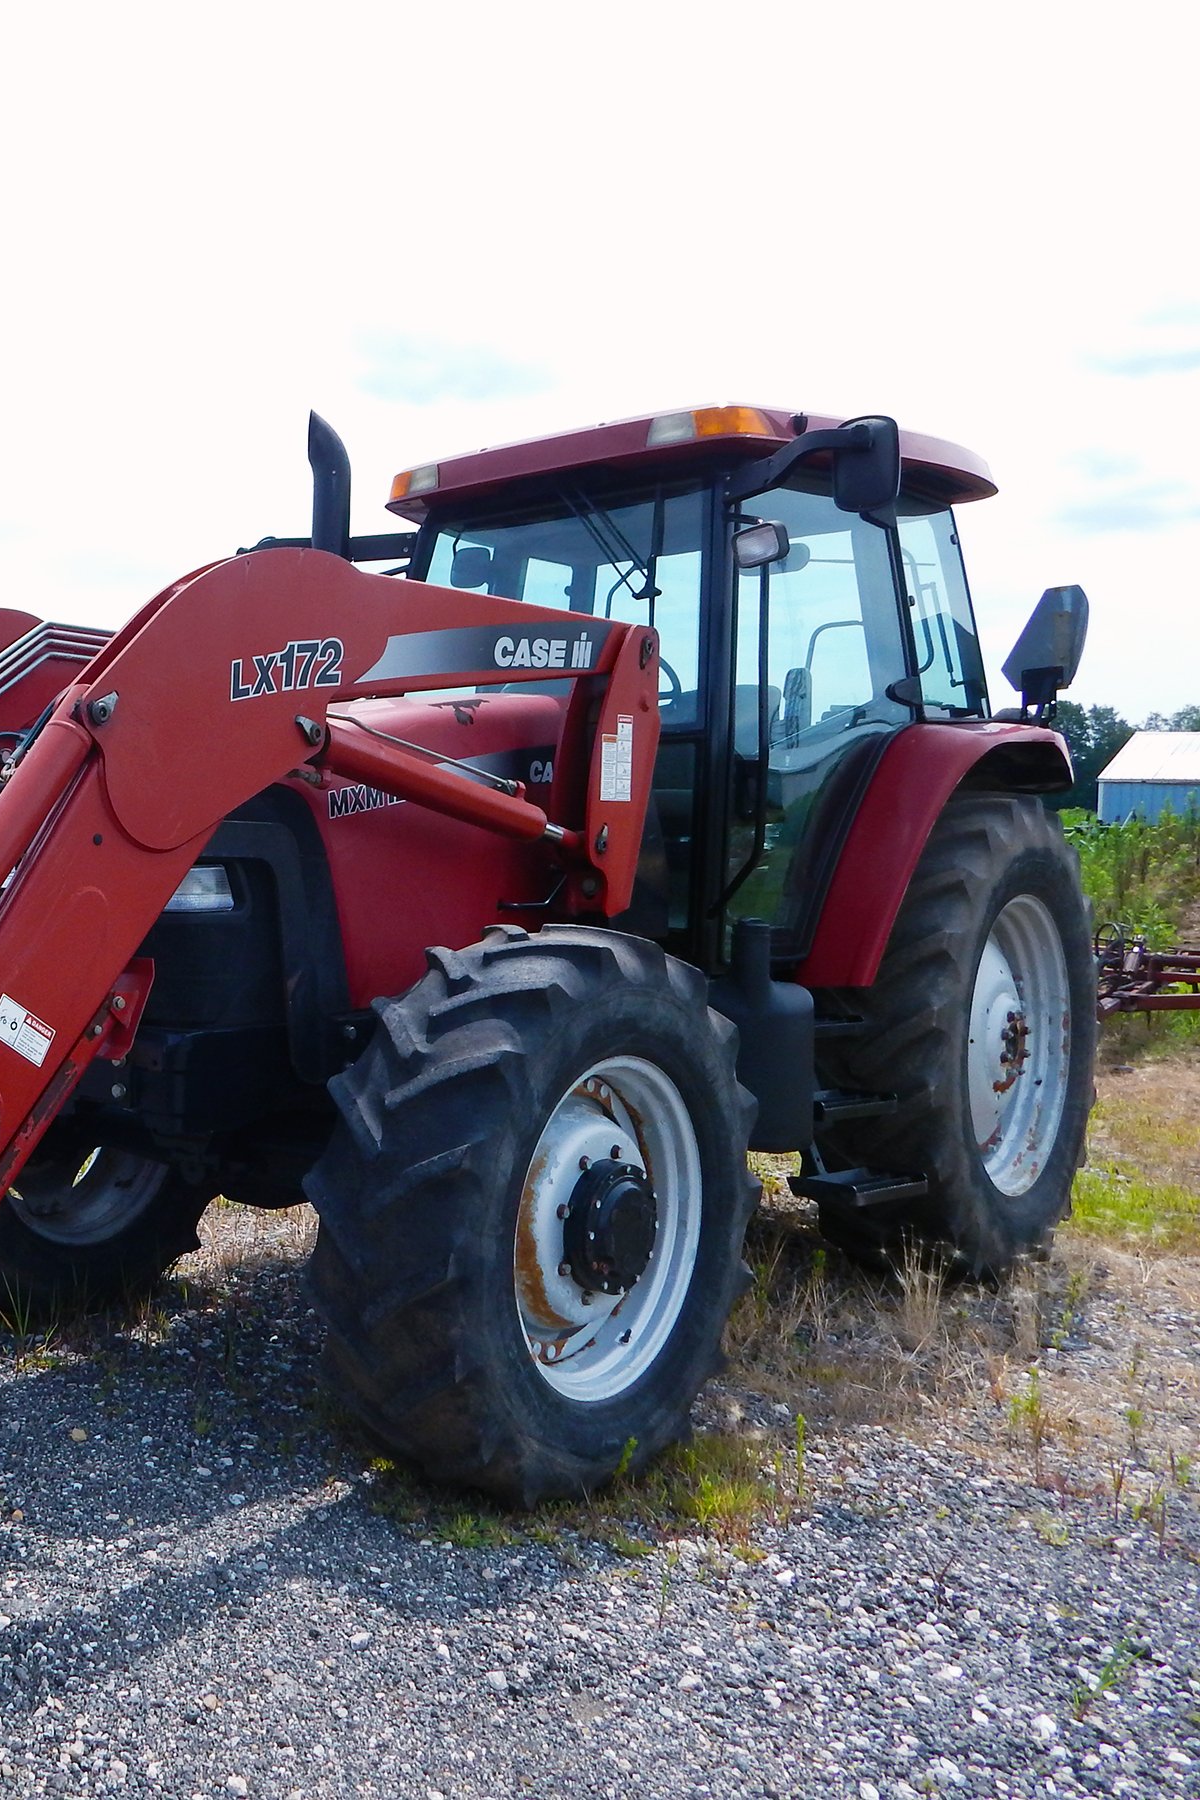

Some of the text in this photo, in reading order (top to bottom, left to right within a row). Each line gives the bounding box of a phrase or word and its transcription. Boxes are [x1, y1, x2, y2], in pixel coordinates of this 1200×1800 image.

[494, 636, 567, 668] CASE
[230, 637, 344, 701] LX172
[31, 1020, 52, 1039] DANGER
